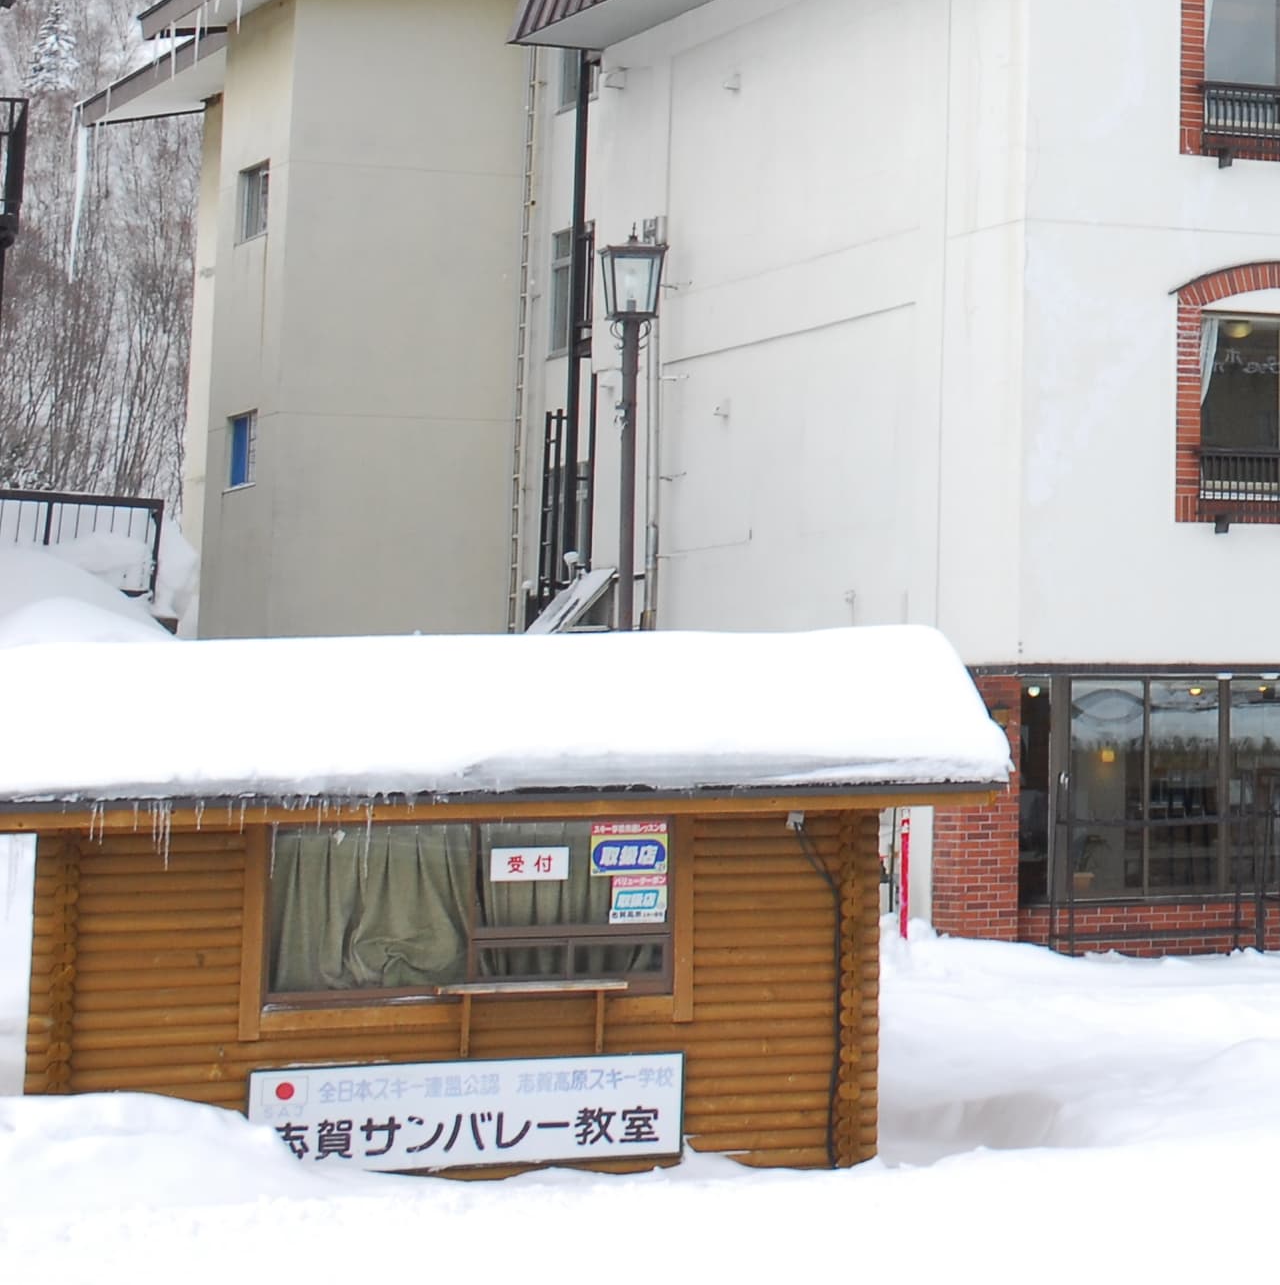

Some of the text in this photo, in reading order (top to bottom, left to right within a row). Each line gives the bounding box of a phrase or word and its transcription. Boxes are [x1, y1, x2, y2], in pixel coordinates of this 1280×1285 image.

[507, 855, 553, 874] 受付
[319, 1067, 675, 1104] 全日本スキー連盟公認 志賀高原スキー学校
[274, 1105, 660, 1162] 志賀サンバレー教室
